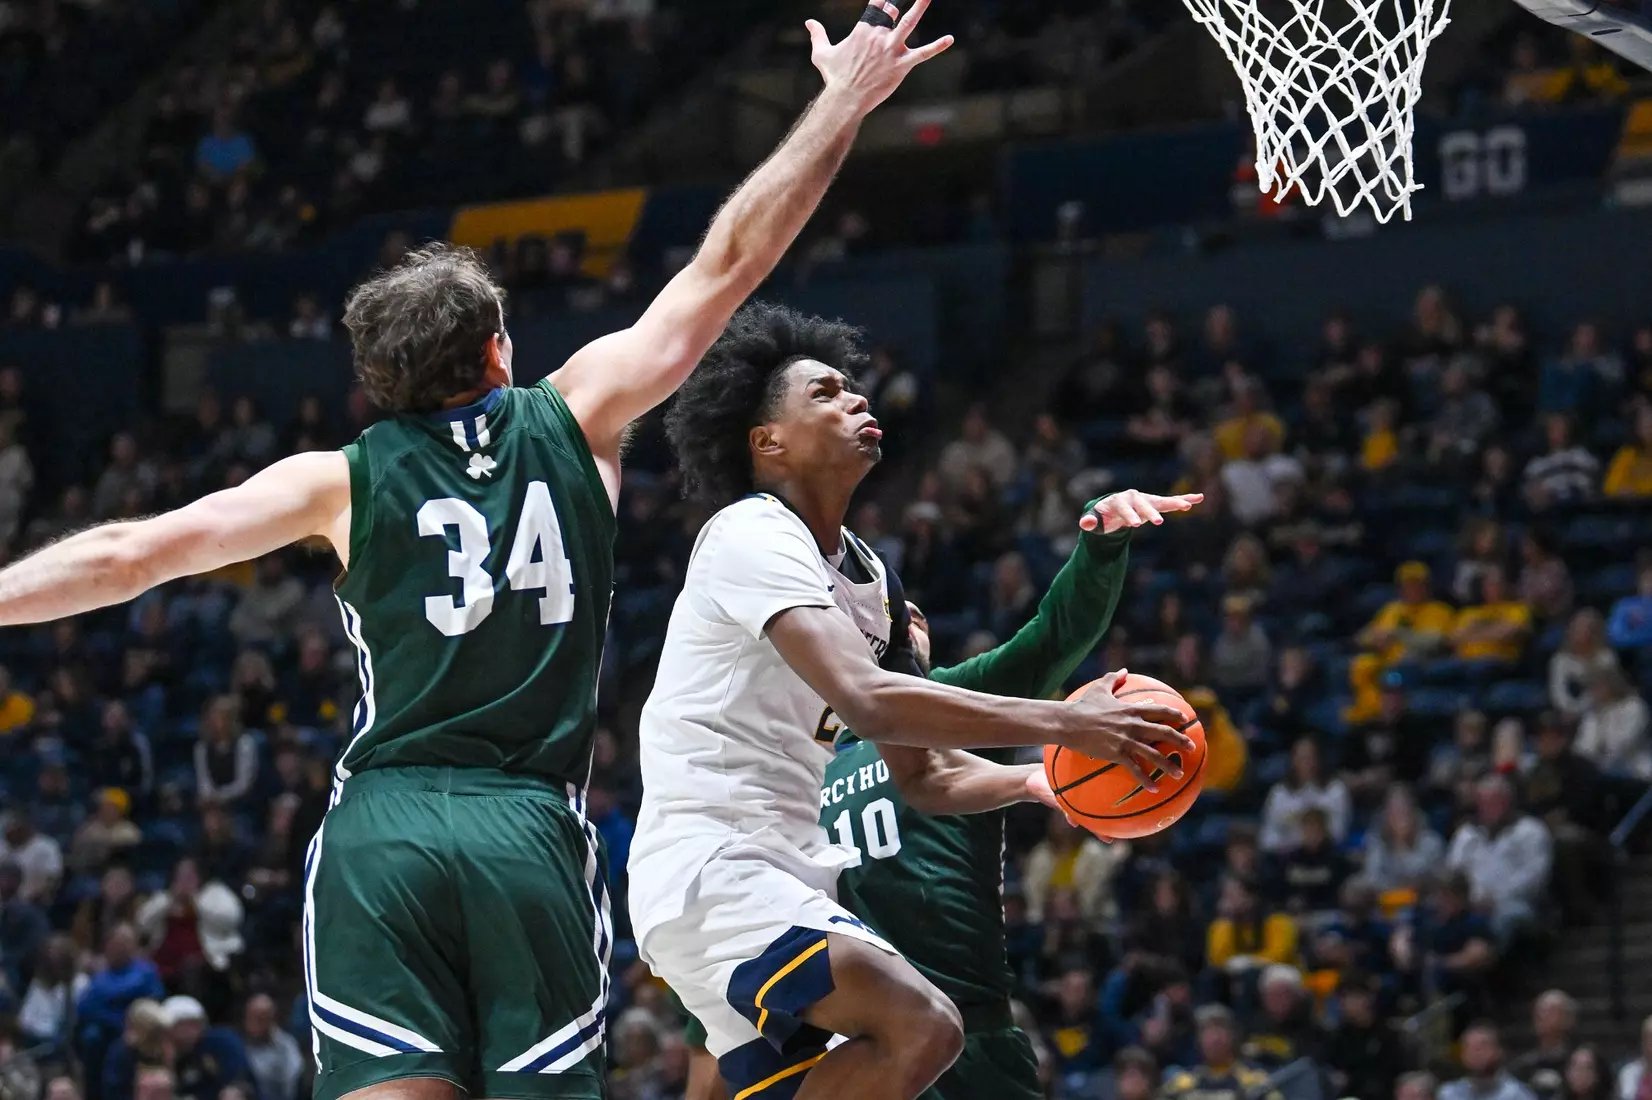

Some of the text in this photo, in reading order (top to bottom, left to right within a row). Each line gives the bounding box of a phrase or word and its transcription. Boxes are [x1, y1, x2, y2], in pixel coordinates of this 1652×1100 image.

[417, 481, 575, 637] 34
[820, 758, 890, 809] RCYHU
[834, 797, 902, 860] 10
